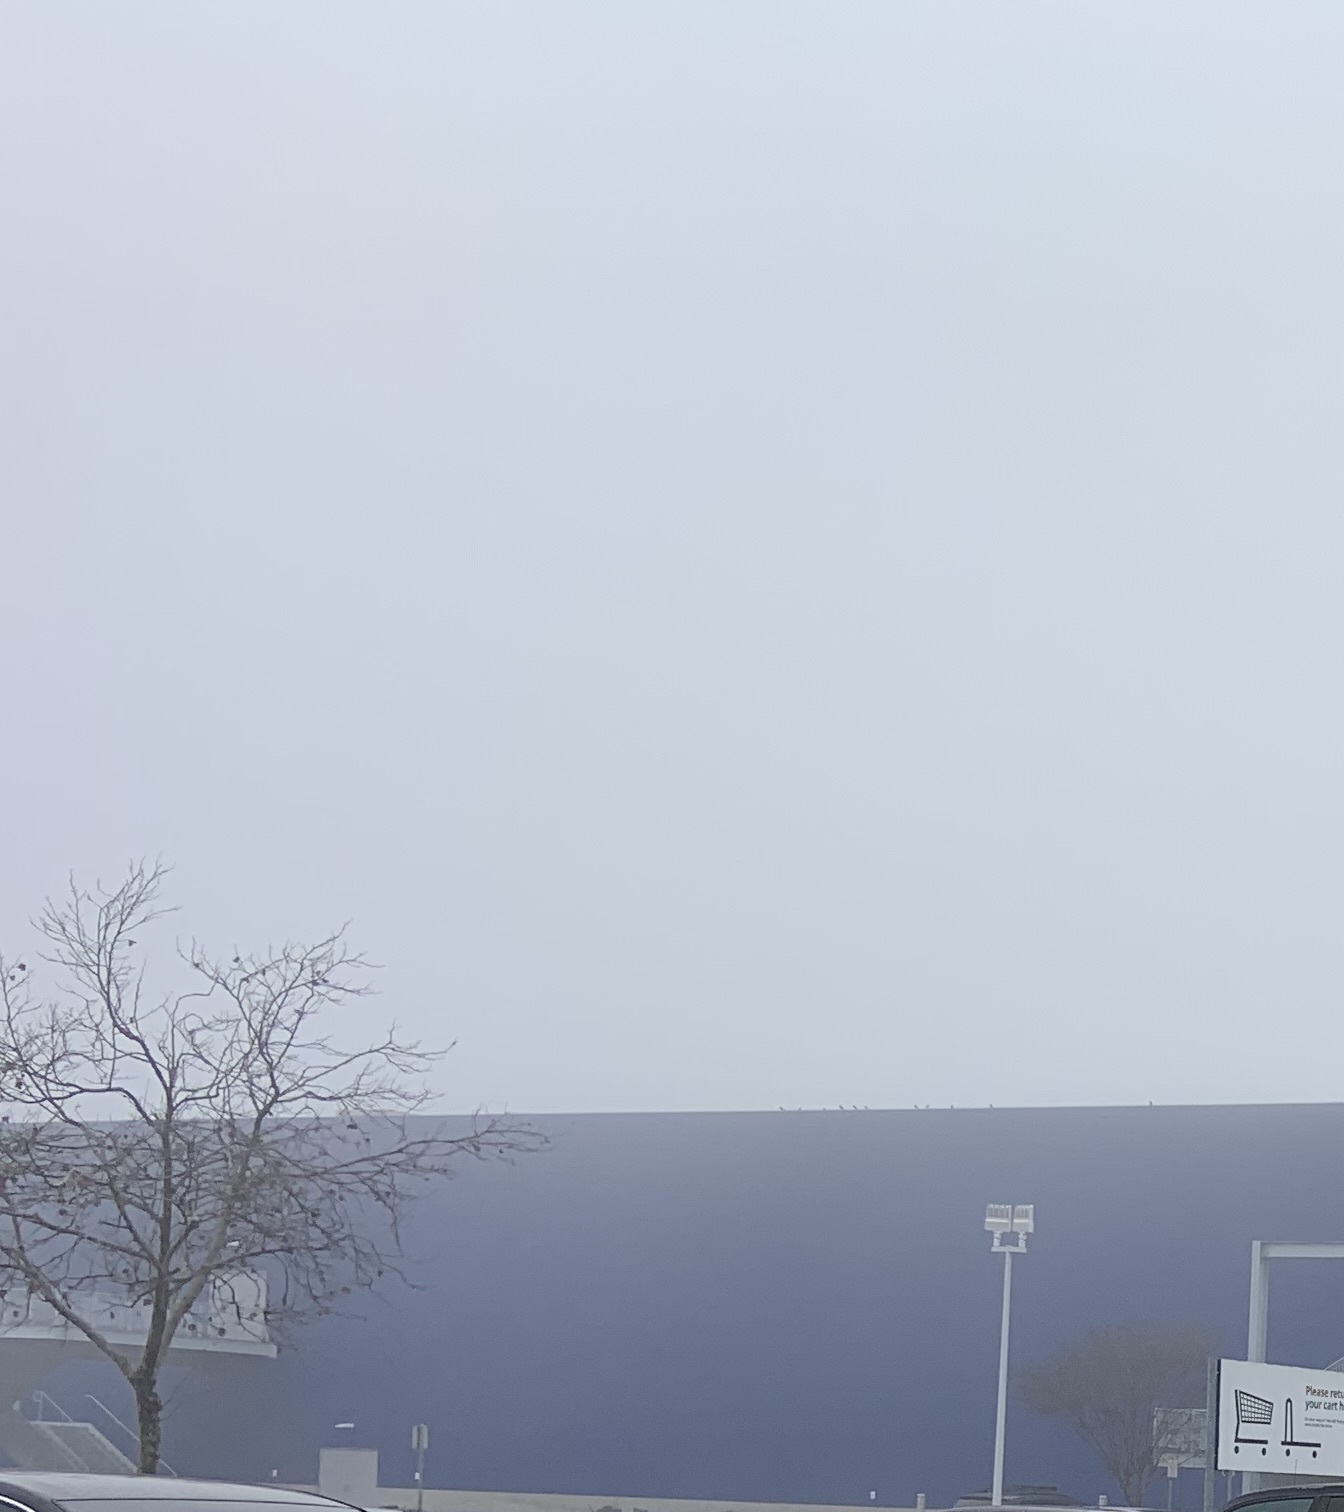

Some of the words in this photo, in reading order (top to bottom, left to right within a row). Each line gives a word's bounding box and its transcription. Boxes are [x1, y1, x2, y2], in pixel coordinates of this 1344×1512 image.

[1305, 1385, 1329, 1398] Please
[1304, 1400, 1323, 1412] your
[1323, 1401, 1338, 1411] cart
